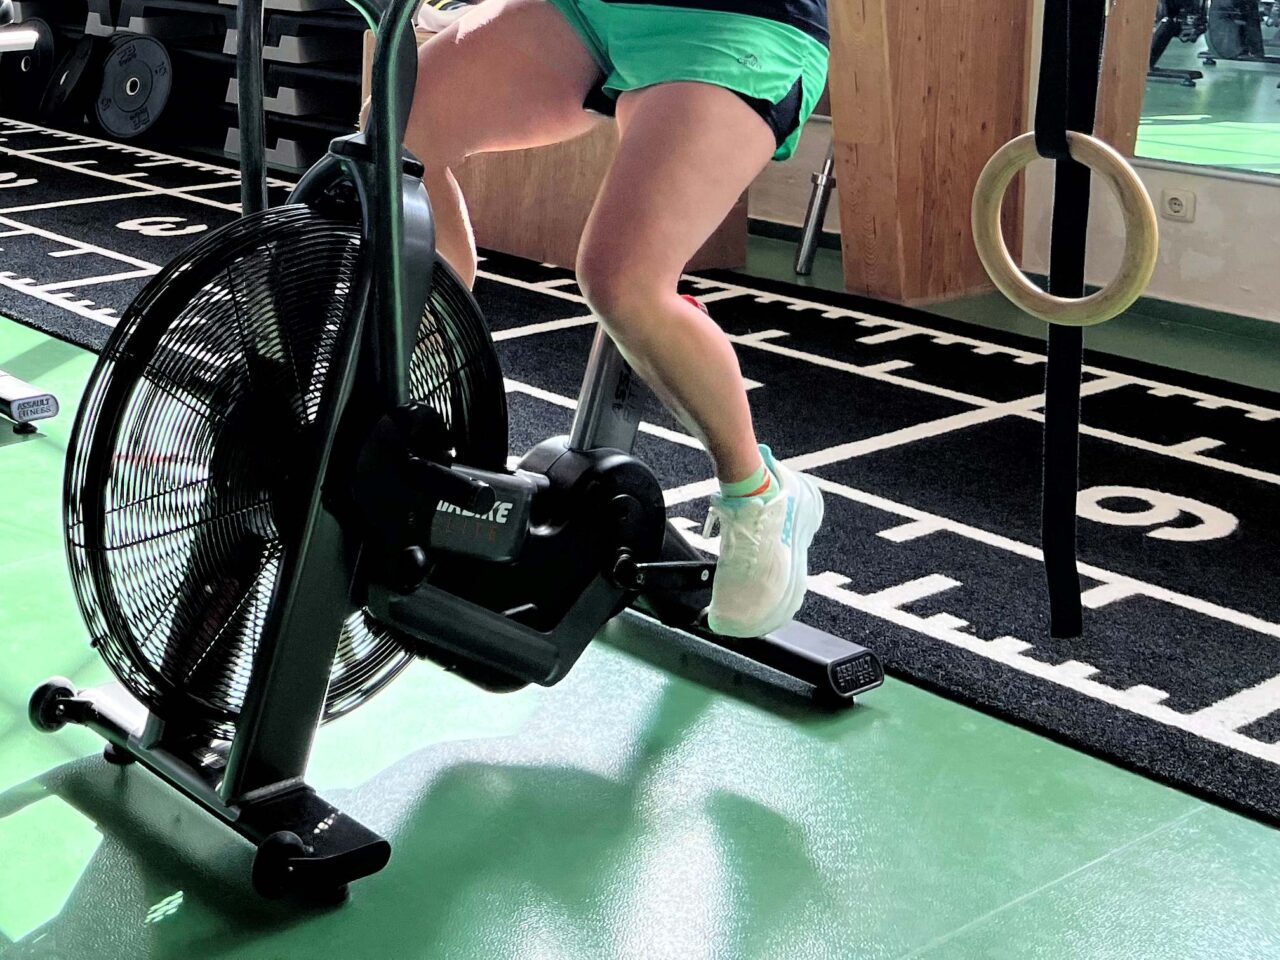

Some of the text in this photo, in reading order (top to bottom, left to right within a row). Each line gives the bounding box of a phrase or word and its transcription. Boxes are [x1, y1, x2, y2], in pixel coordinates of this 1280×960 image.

[17, 397, 51, 411] ASSAULT
[18, 406, 52, 419] FITNESS
[836, 655, 872, 680] ASSAULT
